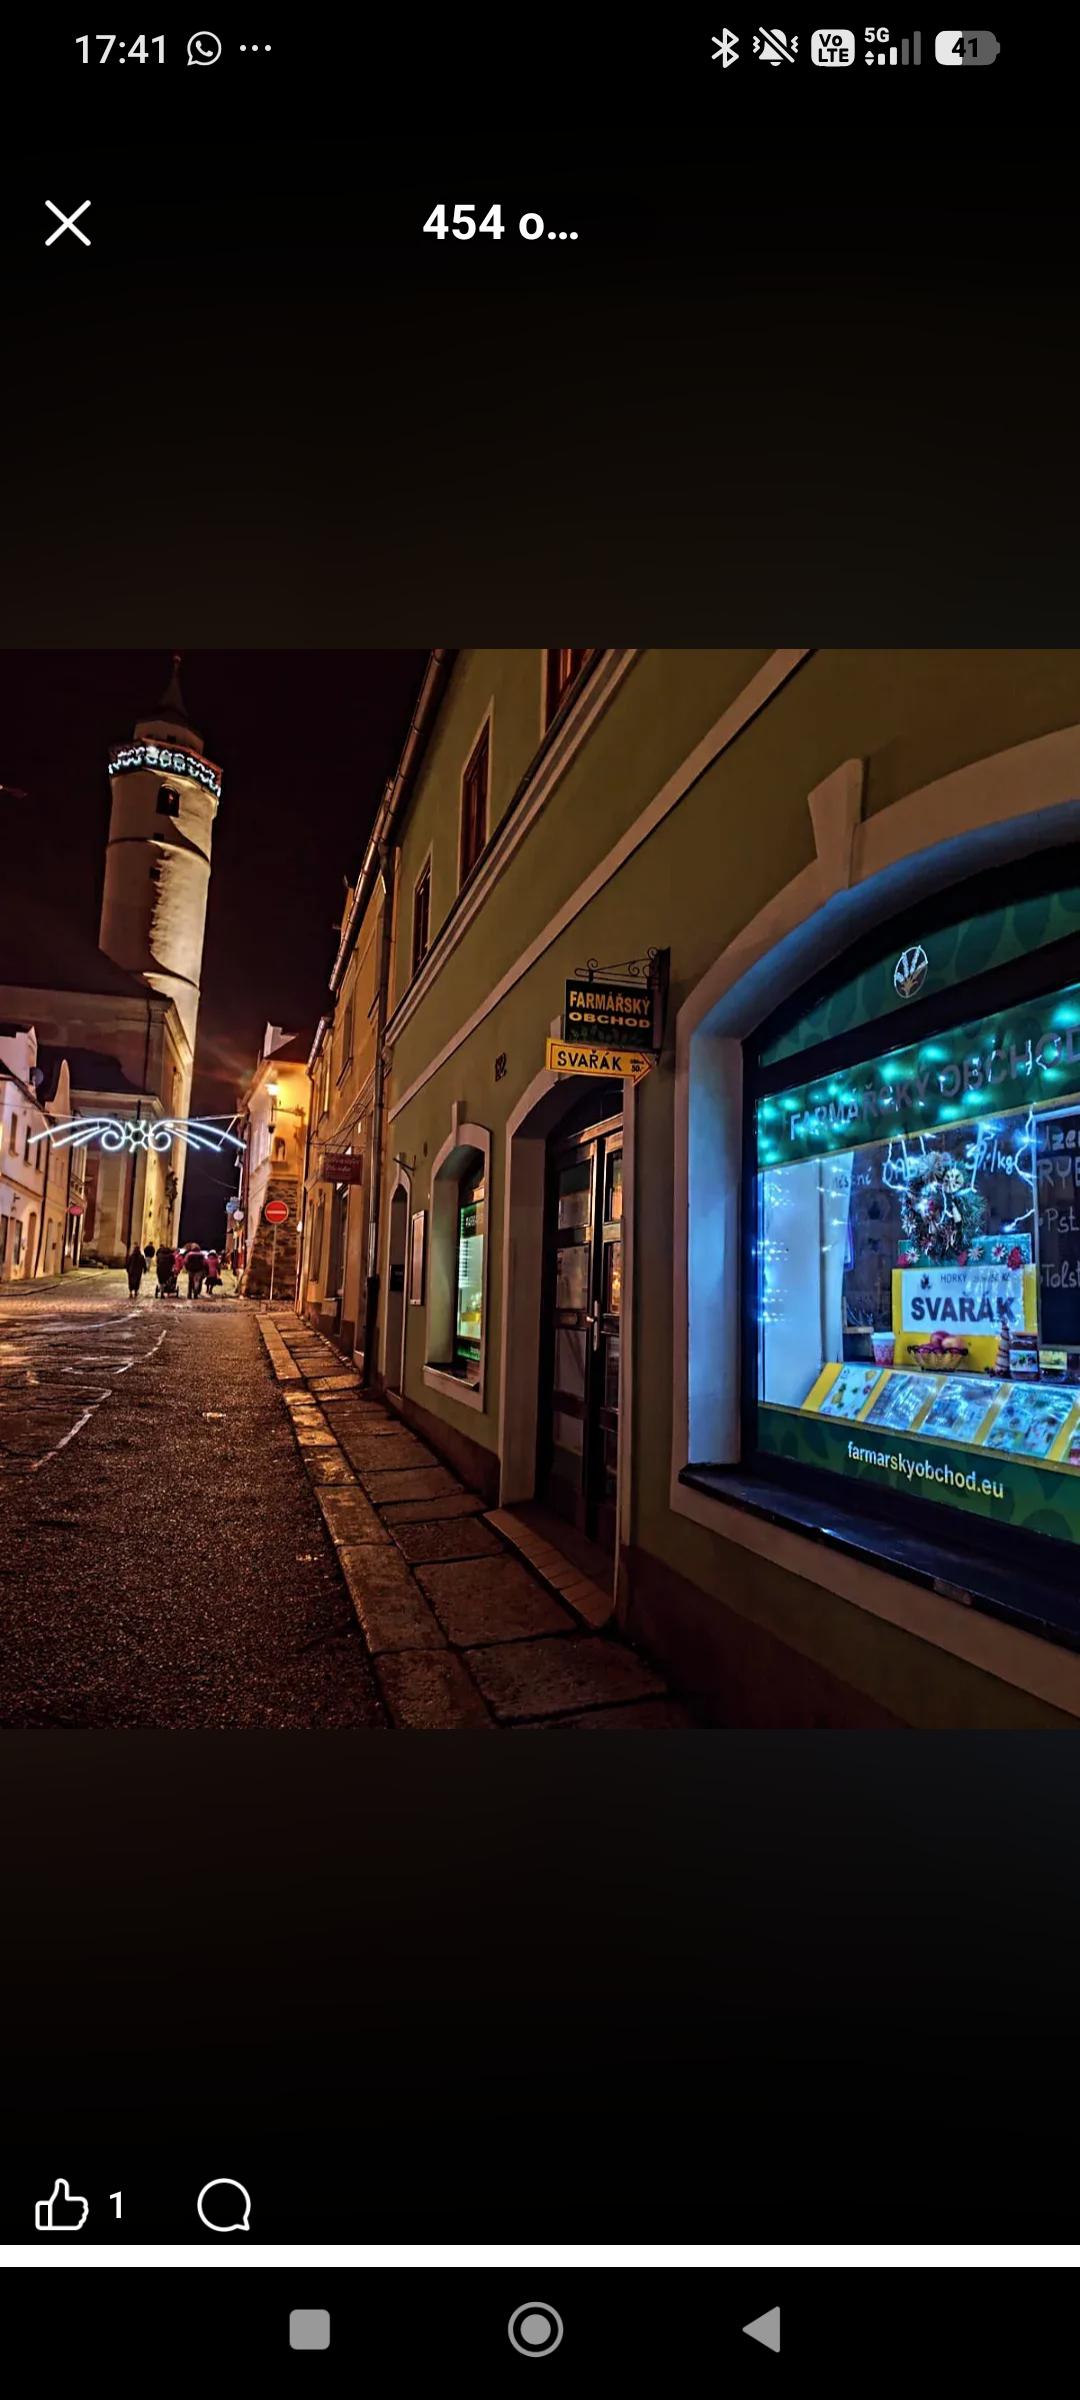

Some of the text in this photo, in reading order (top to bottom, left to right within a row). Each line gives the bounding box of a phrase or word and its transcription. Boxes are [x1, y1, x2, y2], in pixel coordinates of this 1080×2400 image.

[569, 990, 650, 1016] FARMÁŘSKÝ
[568, 1012, 651, 1029] OBCHOD
[557, 1049, 622, 1072] SVAŘÁK
[847, 1440, 1005, 1500] farmarskyobchod.eu
